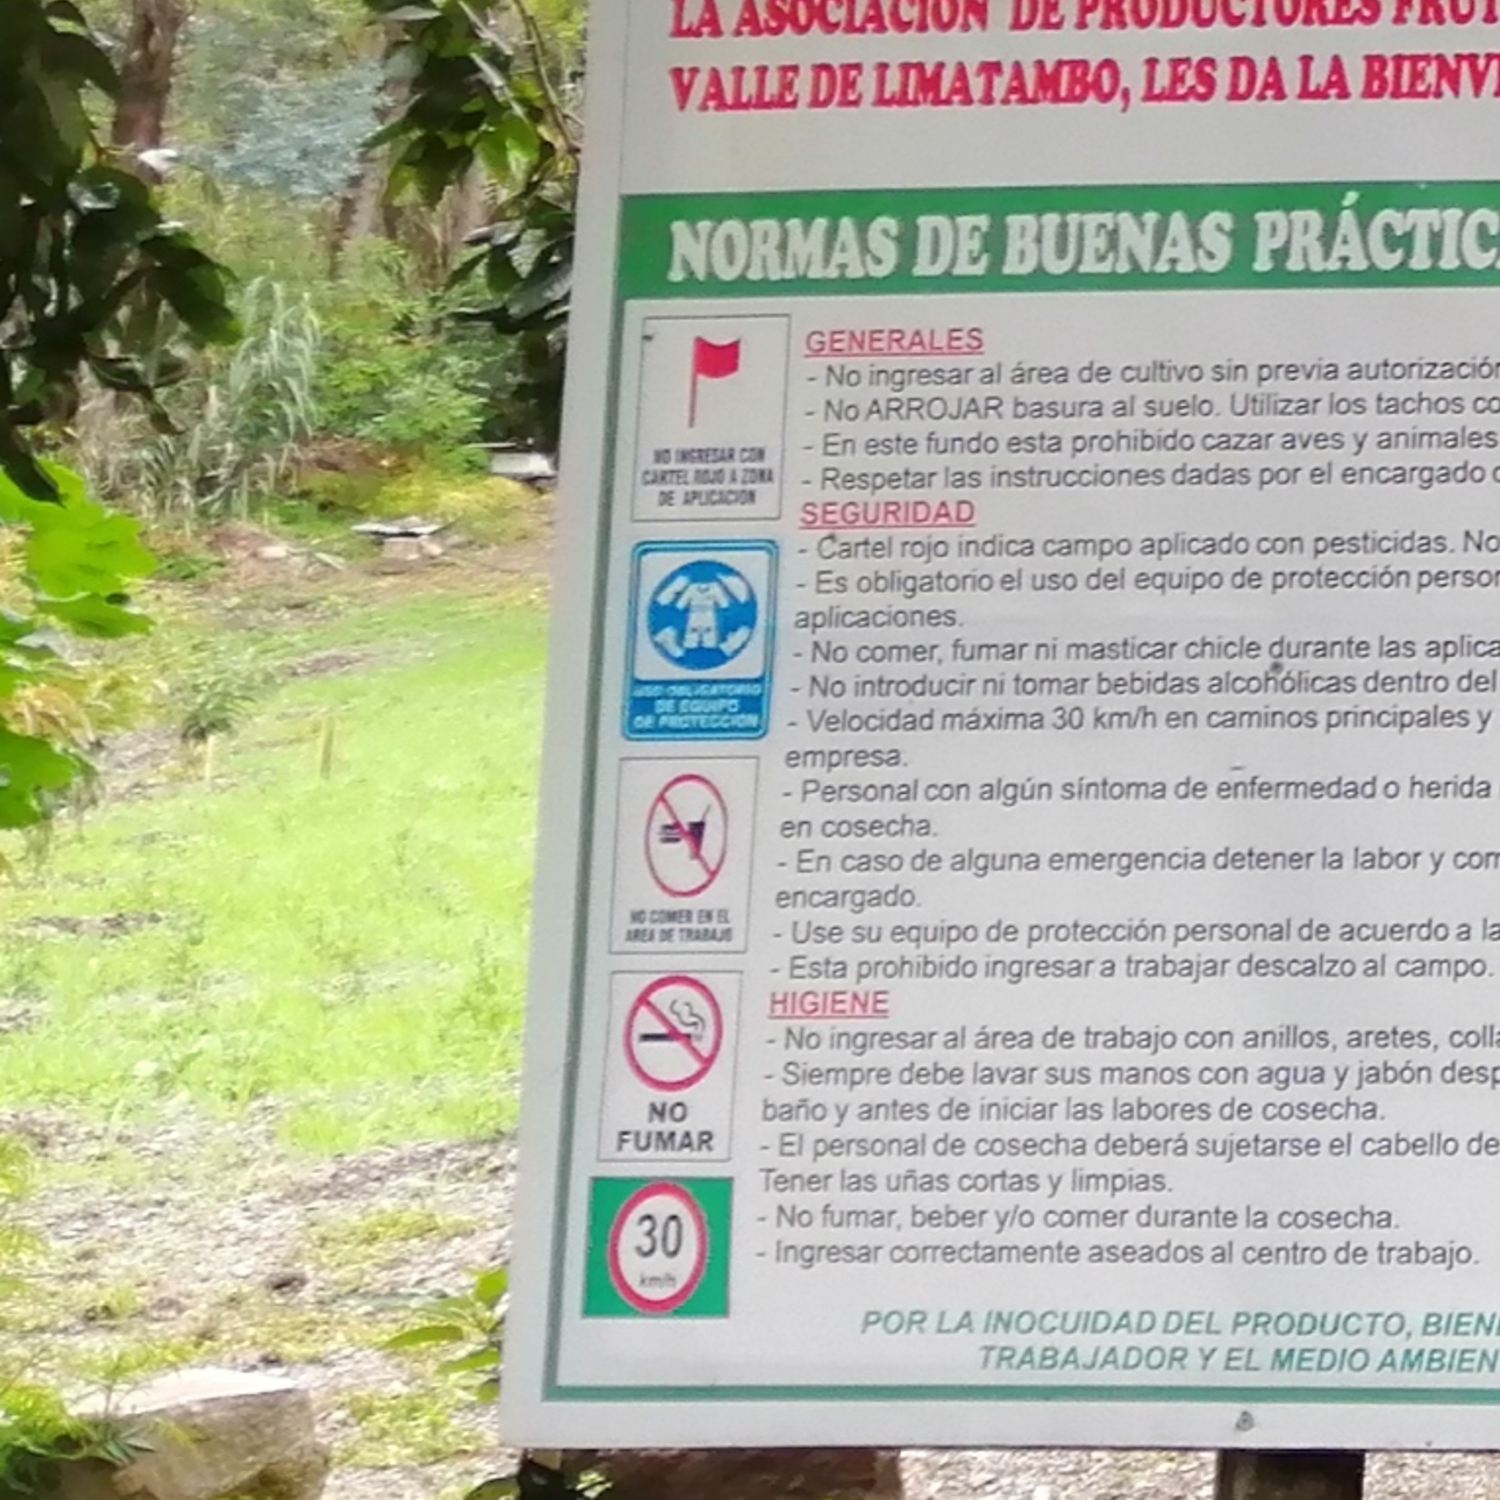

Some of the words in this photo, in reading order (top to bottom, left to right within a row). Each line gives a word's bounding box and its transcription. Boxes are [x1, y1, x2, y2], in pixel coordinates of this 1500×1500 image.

[672, 65, 800, 113] VALLE
[809, 63, 863, 109] DE
[874, 59, 1131, 108] LIMATAMBO,
[1143, 58, 1217, 104] LES
[1227, 56, 1287, 103] DA
[1298, 56, 1351, 101] LA
[668, 216, 900, 282] NORMAS
[912, 213, 991, 276] DE
[1002, 210, 1235, 275] BUENAS
[805, 327, 984, 353] GENERALES
[827, 364, 861, 387] No
[869, 363, 974, 392] ingresar
[979, 361, 1002, 385] al
[1010, 361, 1069, 385] área
[1078, 360, 1111, 384] de
[1121, 360, 1203, 383] cultivo
[1212, 359, 1248, 383] sin
[1257, 358, 1339, 387] previa
[823, 432, 855, 457] En
[865, 434, 918, 456] este
[926, 430, 999, 455] fundo
[1007, 431, 1062, 453] esta
[1071, 428, 1195, 459] prohibido
[1201, 432, 1274, 452] cazar
[1281, 431, 1345, 451] aves
[1353, 432, 1368, 456] y
[1376, 424, 1499, 450] animales
[800, 500, 976, 525] SEGURIDAD
[794, 604, 963, 635] aplicaciones.
[785, 749, 907, 773] empresa.
[780, 819, 812, 838] en
[821, 813, 937, 838] cosecha.
[775, 884, 920, 914] encargado.
[770, 991, 890, 1016] HIGIENE
[648, 1101, 688, 1123] NO
[763, 1098, 827, 1121] baño
[835, 1104, 848, 1127] y
[858, 1099, 930, 1121] antes
[938, 1097, 970, 1121] de
[980, 1097, 1059, 1121] iniciar
[1066, 1096, 1104, 1121] las
[1113, 1096, 1211, 1121] labores
[1219, 1096, 1253, 1121] de
[1261, 1096, 1385, 1121] cosecha.
[616, 1129, 713, 1152] FUMAR
[759, 1167, 833, 1193] Tener
[841, 1168, 877, 1192] las
[886, 1168, 950, 1192] uñas
[958, 1169, 1040, 1192] cortas
[1048, 1173, 1063, 1199] y
[1072, 1167, 1172, 1198] limpias.
[634, 1213, 683, 1259] 30
[776, 1240, 883, 1270] Ingresar
[890, 1240, 1080, 1264] correctamente
[1088, 1239, 1204, 1264] aseados
[1211, 1240, 1233, 1264] al
[1242, 1241, 1327, 1266] centro
[1334, 1239, 1368, 1265] de
[1377, 1239, 1479, 1271] trabajo.
[861, 1310, 928, 1335] POR
[935, 1310, 974, 1334] LA
[983, 1310, 1157, 1335] INOCUIDAD
[1161, 1310, 1221, 1335] DEL
[1231, 1311, 1412, 1341] PRODUCTO,
[981, 1345, 1189, 1371] TRABAJADOR
[1199, 1347, 1218, 1371] Y
[1223, 1347, 1261, 1371] EL
[1270, 1347, 1371, 1372] MEDIO
